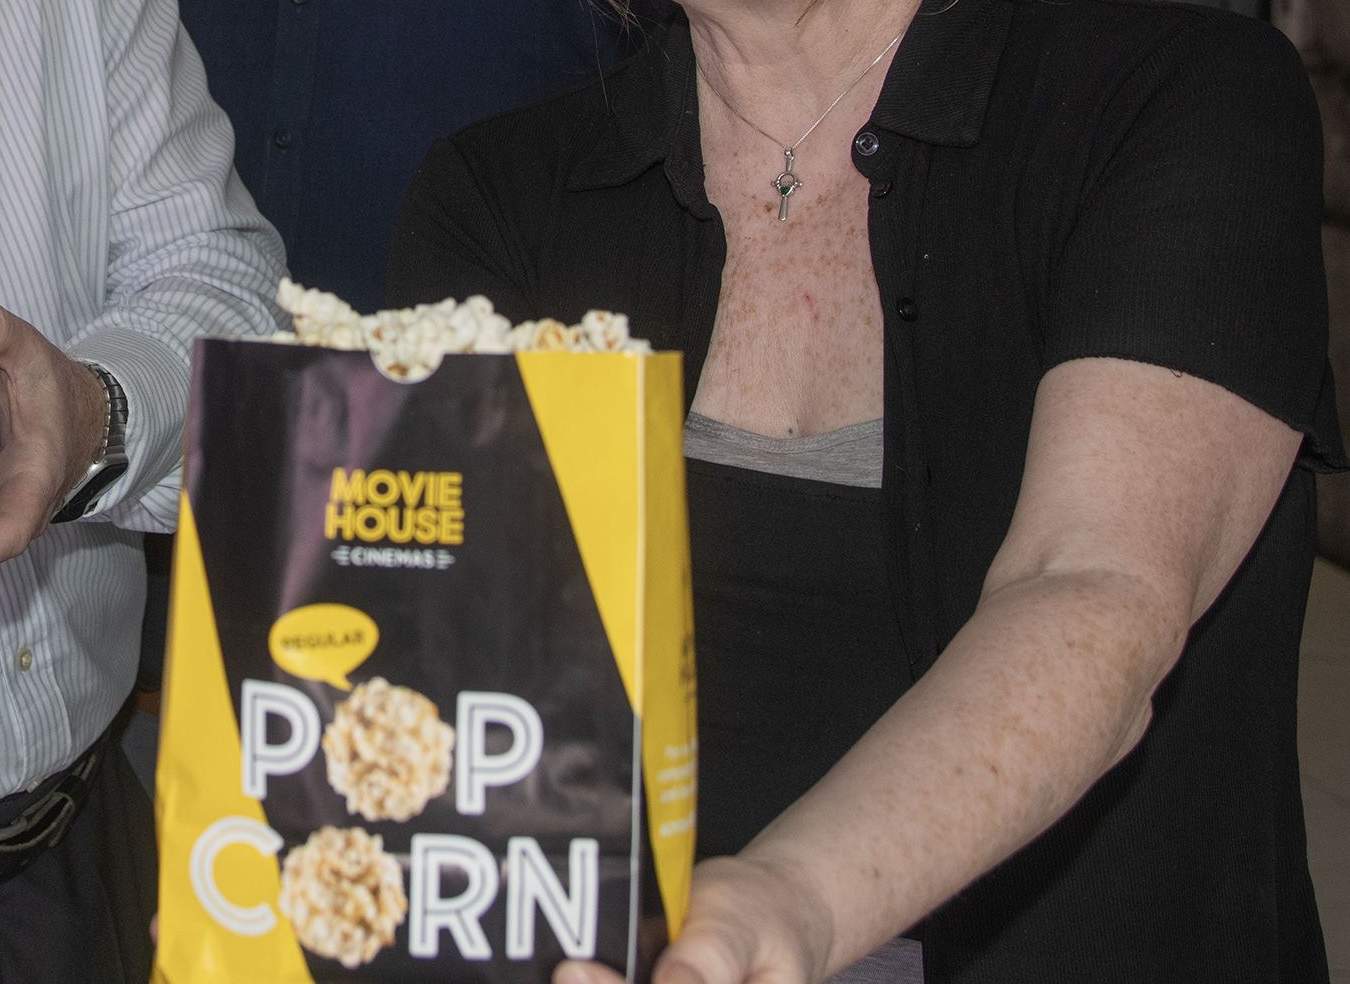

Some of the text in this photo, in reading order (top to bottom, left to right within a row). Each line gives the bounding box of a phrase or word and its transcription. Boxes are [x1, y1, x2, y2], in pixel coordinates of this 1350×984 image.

[329, 466, 464, 508] MOVIE
[323, 502, 466, 546] HOUSE
[350, 546, 436, 569] CINEMAS
